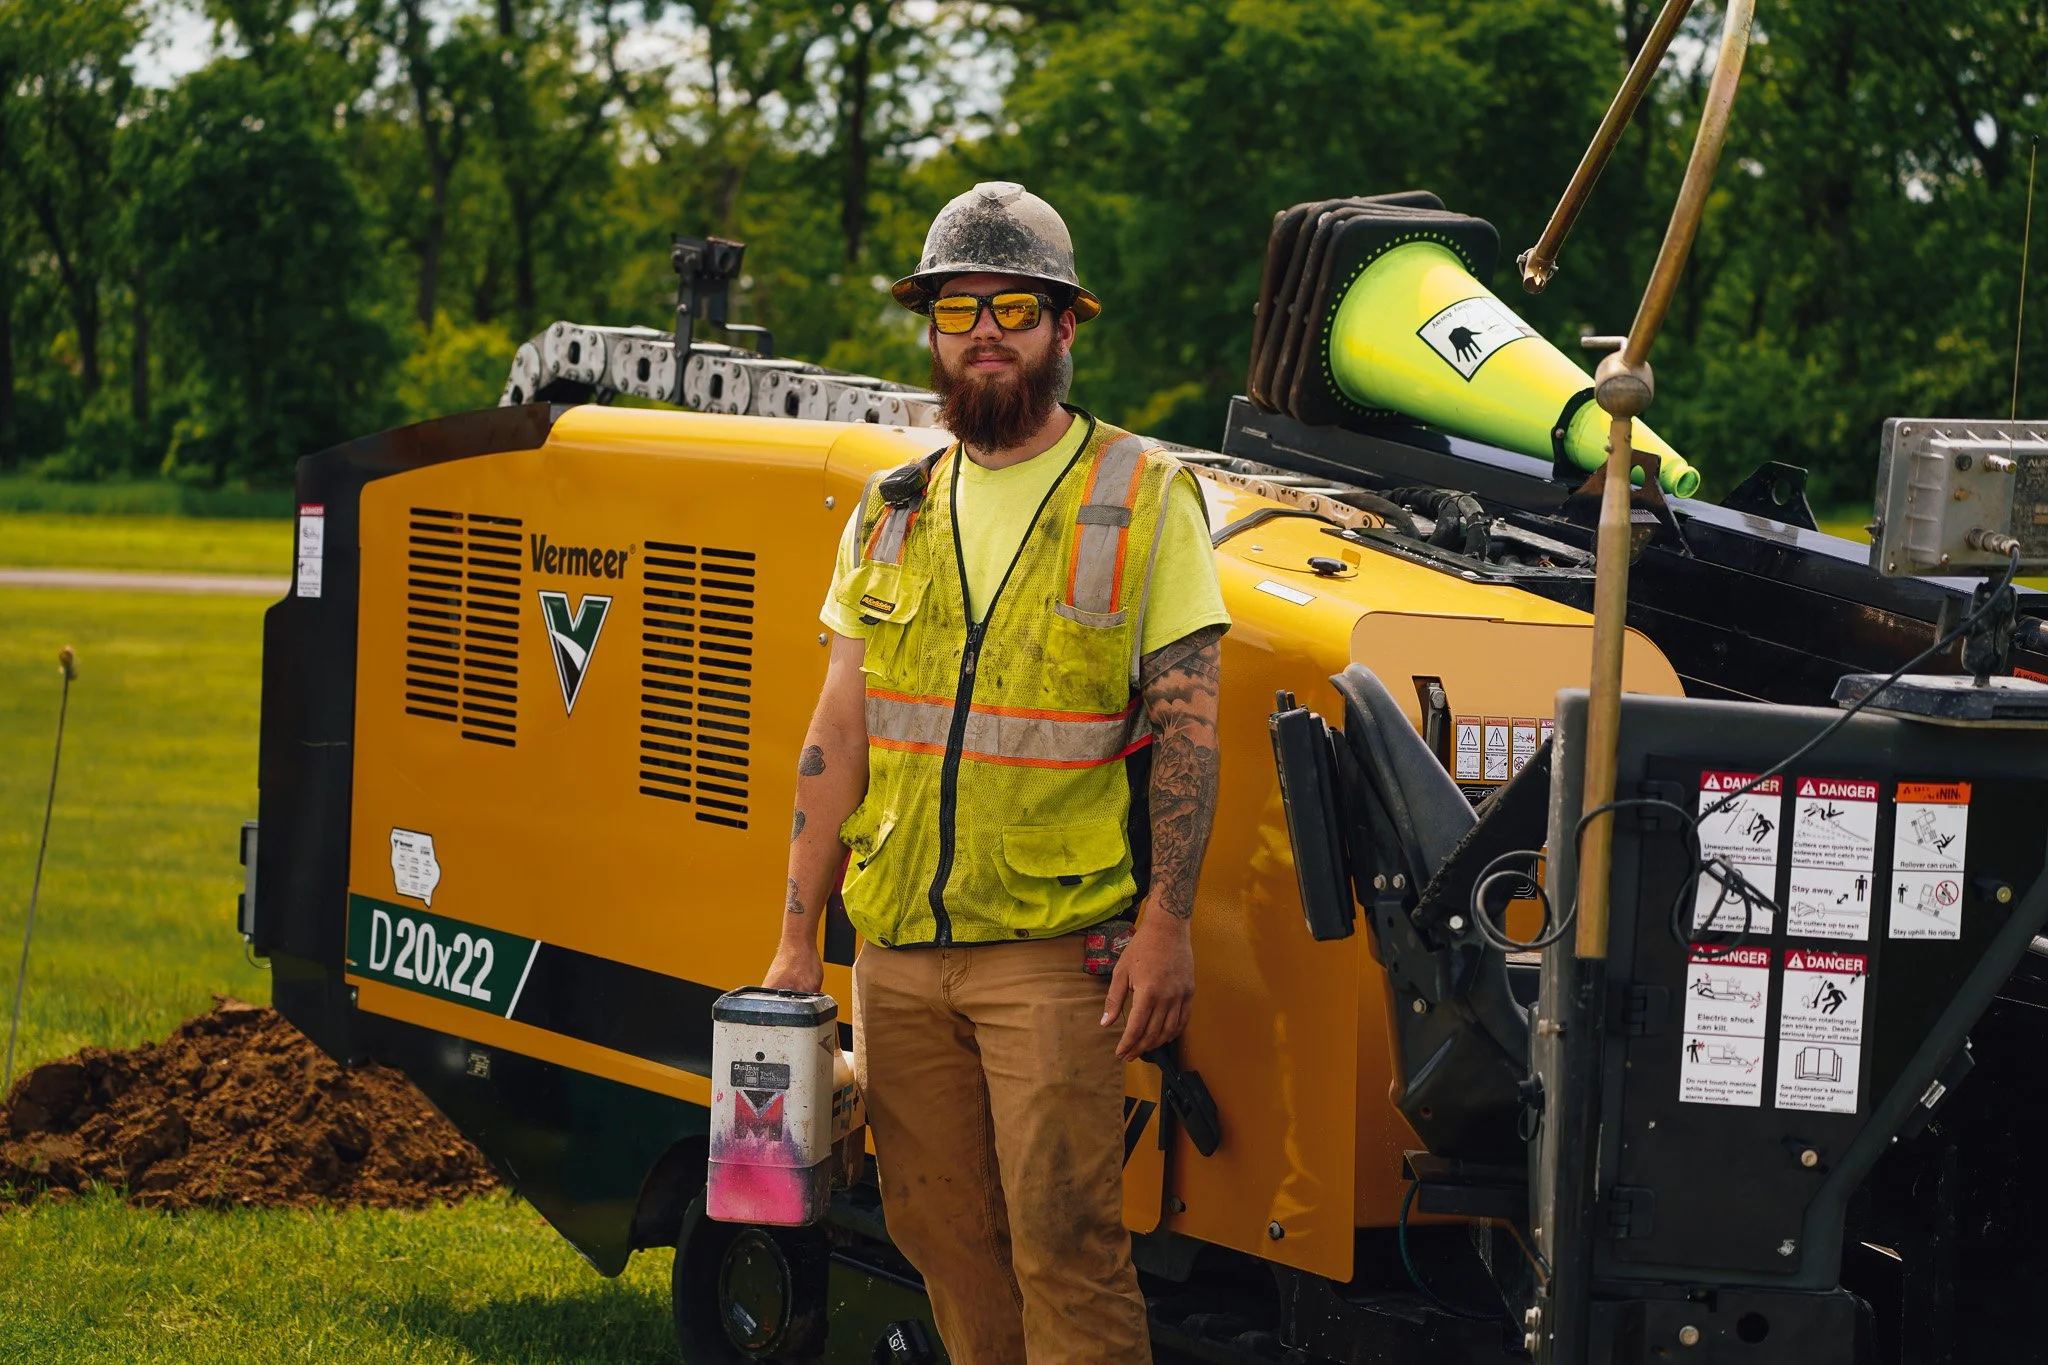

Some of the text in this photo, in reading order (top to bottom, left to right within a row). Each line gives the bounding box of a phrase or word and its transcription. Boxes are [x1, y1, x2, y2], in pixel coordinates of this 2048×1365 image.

[530, 533, 628, 579] Vermeer
[1819, 783, 1876, 799] DANGER
[1704, 843, 1744, 851] Unexpected
[1791, 885, 1835, 895] Stay away.
[1807, 955, 1863, 971] DANGER
[1697, 1013, 1755, 1024] Electric shock
[1819, 1017, 1844, 1025] rotating
[1714, 1024, 1728, 1032] kill.
[1704, 1087, 1726, 1095] boring
[1830, 1087, 1854, 1095] Manual
